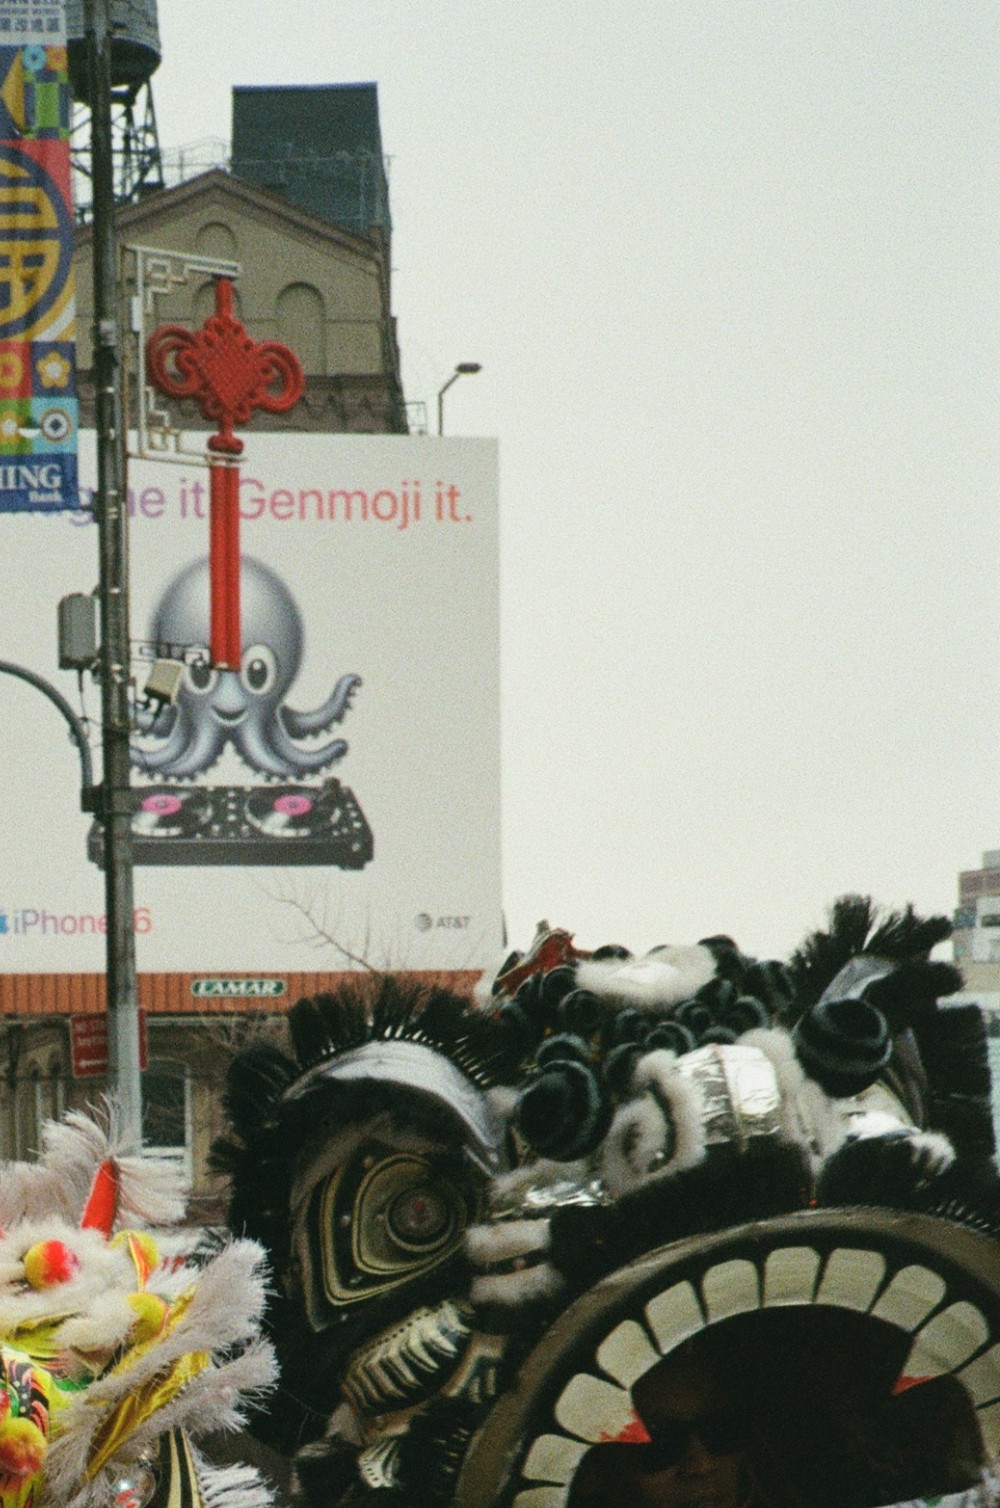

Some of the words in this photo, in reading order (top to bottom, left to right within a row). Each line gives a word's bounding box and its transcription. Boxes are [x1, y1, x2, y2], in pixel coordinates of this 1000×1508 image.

[239, 478, 421, 531] Genmoji
[435, 480, 473, 522] it.
[436, 915, 471, 929] AT&T
[198, 980, 276, 995] LAMAR
